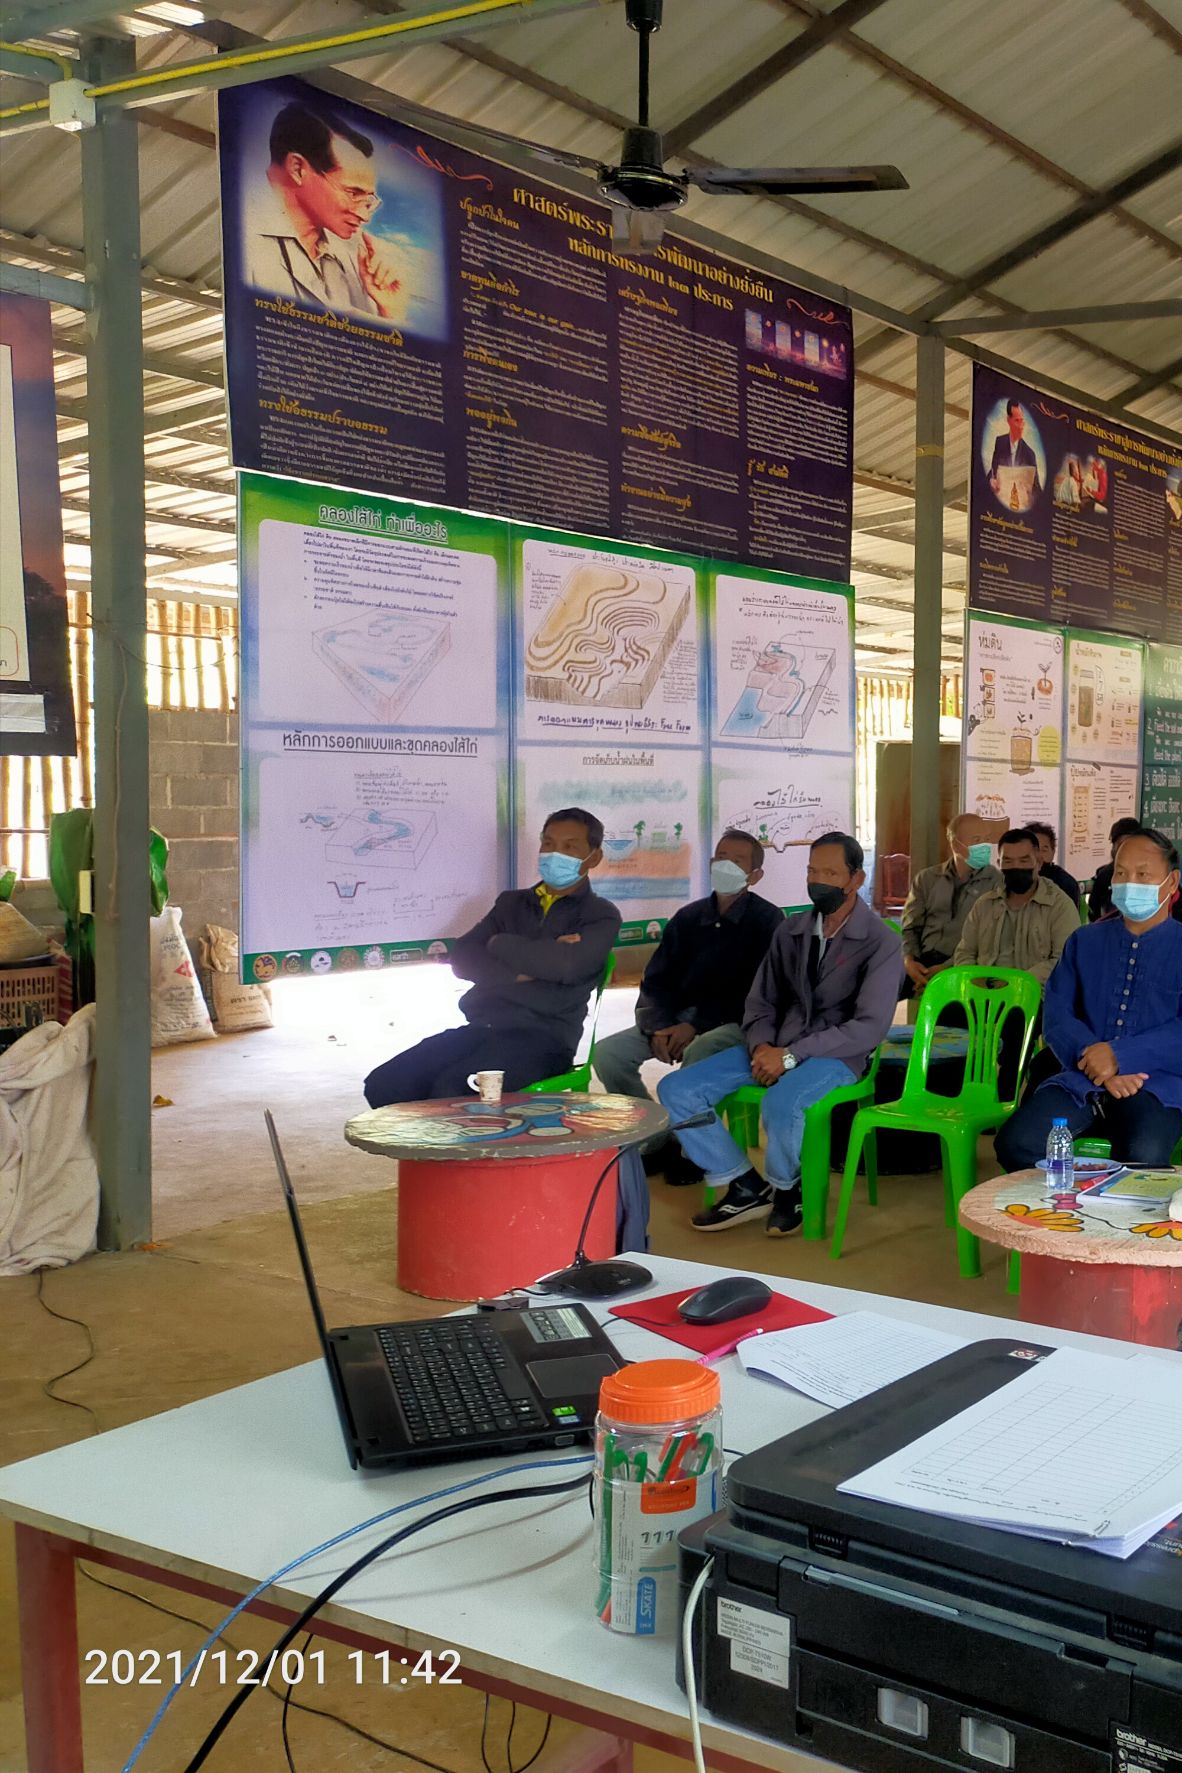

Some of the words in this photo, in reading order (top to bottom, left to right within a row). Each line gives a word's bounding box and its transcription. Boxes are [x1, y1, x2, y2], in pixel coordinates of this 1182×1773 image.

[693, 283, 734, 311] ประการ
[319, 504, 382, 530] คลองไส้ไก่
[386, 512, 448, 541] ทำเพื่ออะไร
[283, 730, 478, 755] หลักการออกแบบและขุดคลองไส้ไก่
[641, 1583, 654, 1619] SKATE
[720, 1600, 743, 1613] brother
[1116, 1728, 1148, 1747] brother
